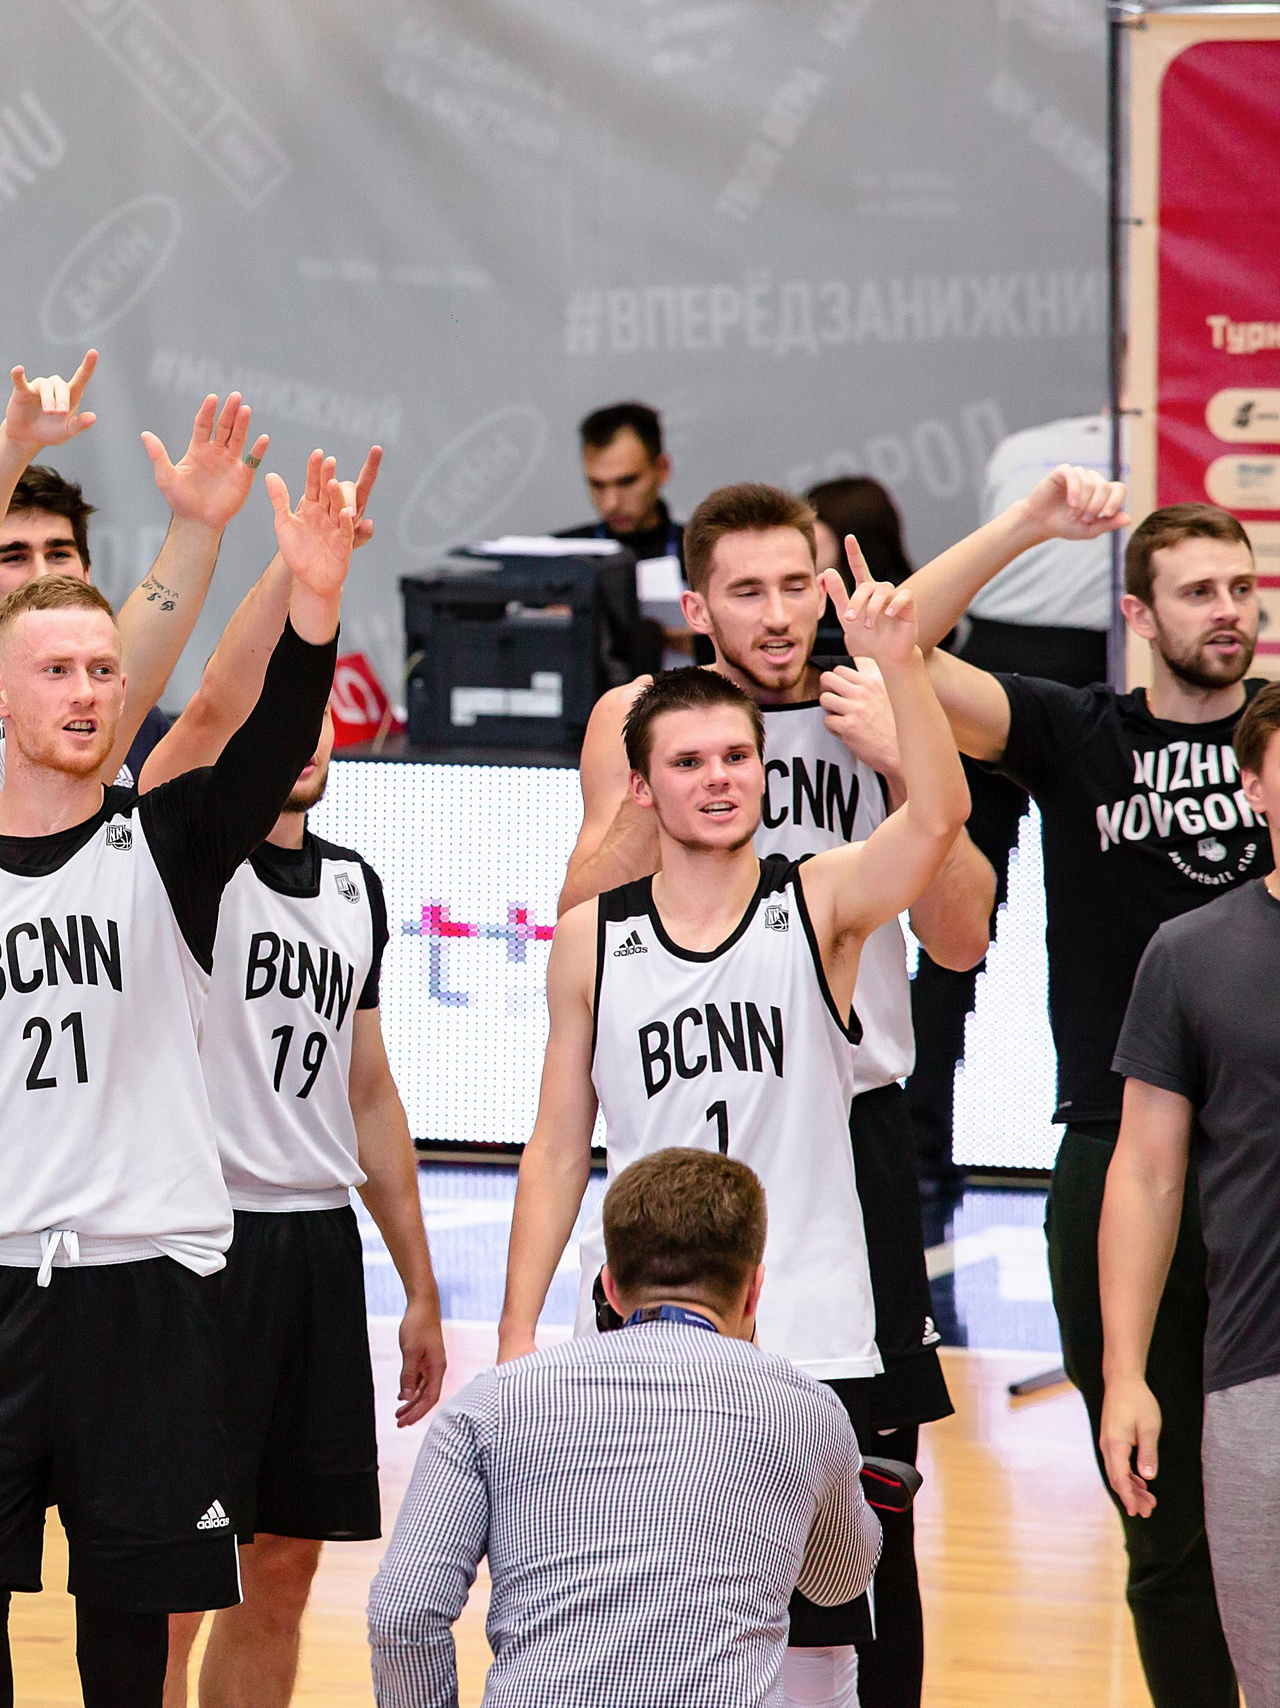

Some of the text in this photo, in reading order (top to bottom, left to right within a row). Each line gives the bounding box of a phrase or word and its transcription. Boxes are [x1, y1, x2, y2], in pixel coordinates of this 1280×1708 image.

[762, 757, 860, 843] CNN
[1237, 843, 1257, 872] club
[245, 931, 354, 1032] BCNN
[613, 944, 648, 957] adidas
[22, 1011, 89, 1091] 21
[270, 1024, 328, 1100] 19
[638, 1002, 783, 1100] BCNN
[706, 1100, 729, 1157] 1
[197, 1517, 230, 1530] adidas
